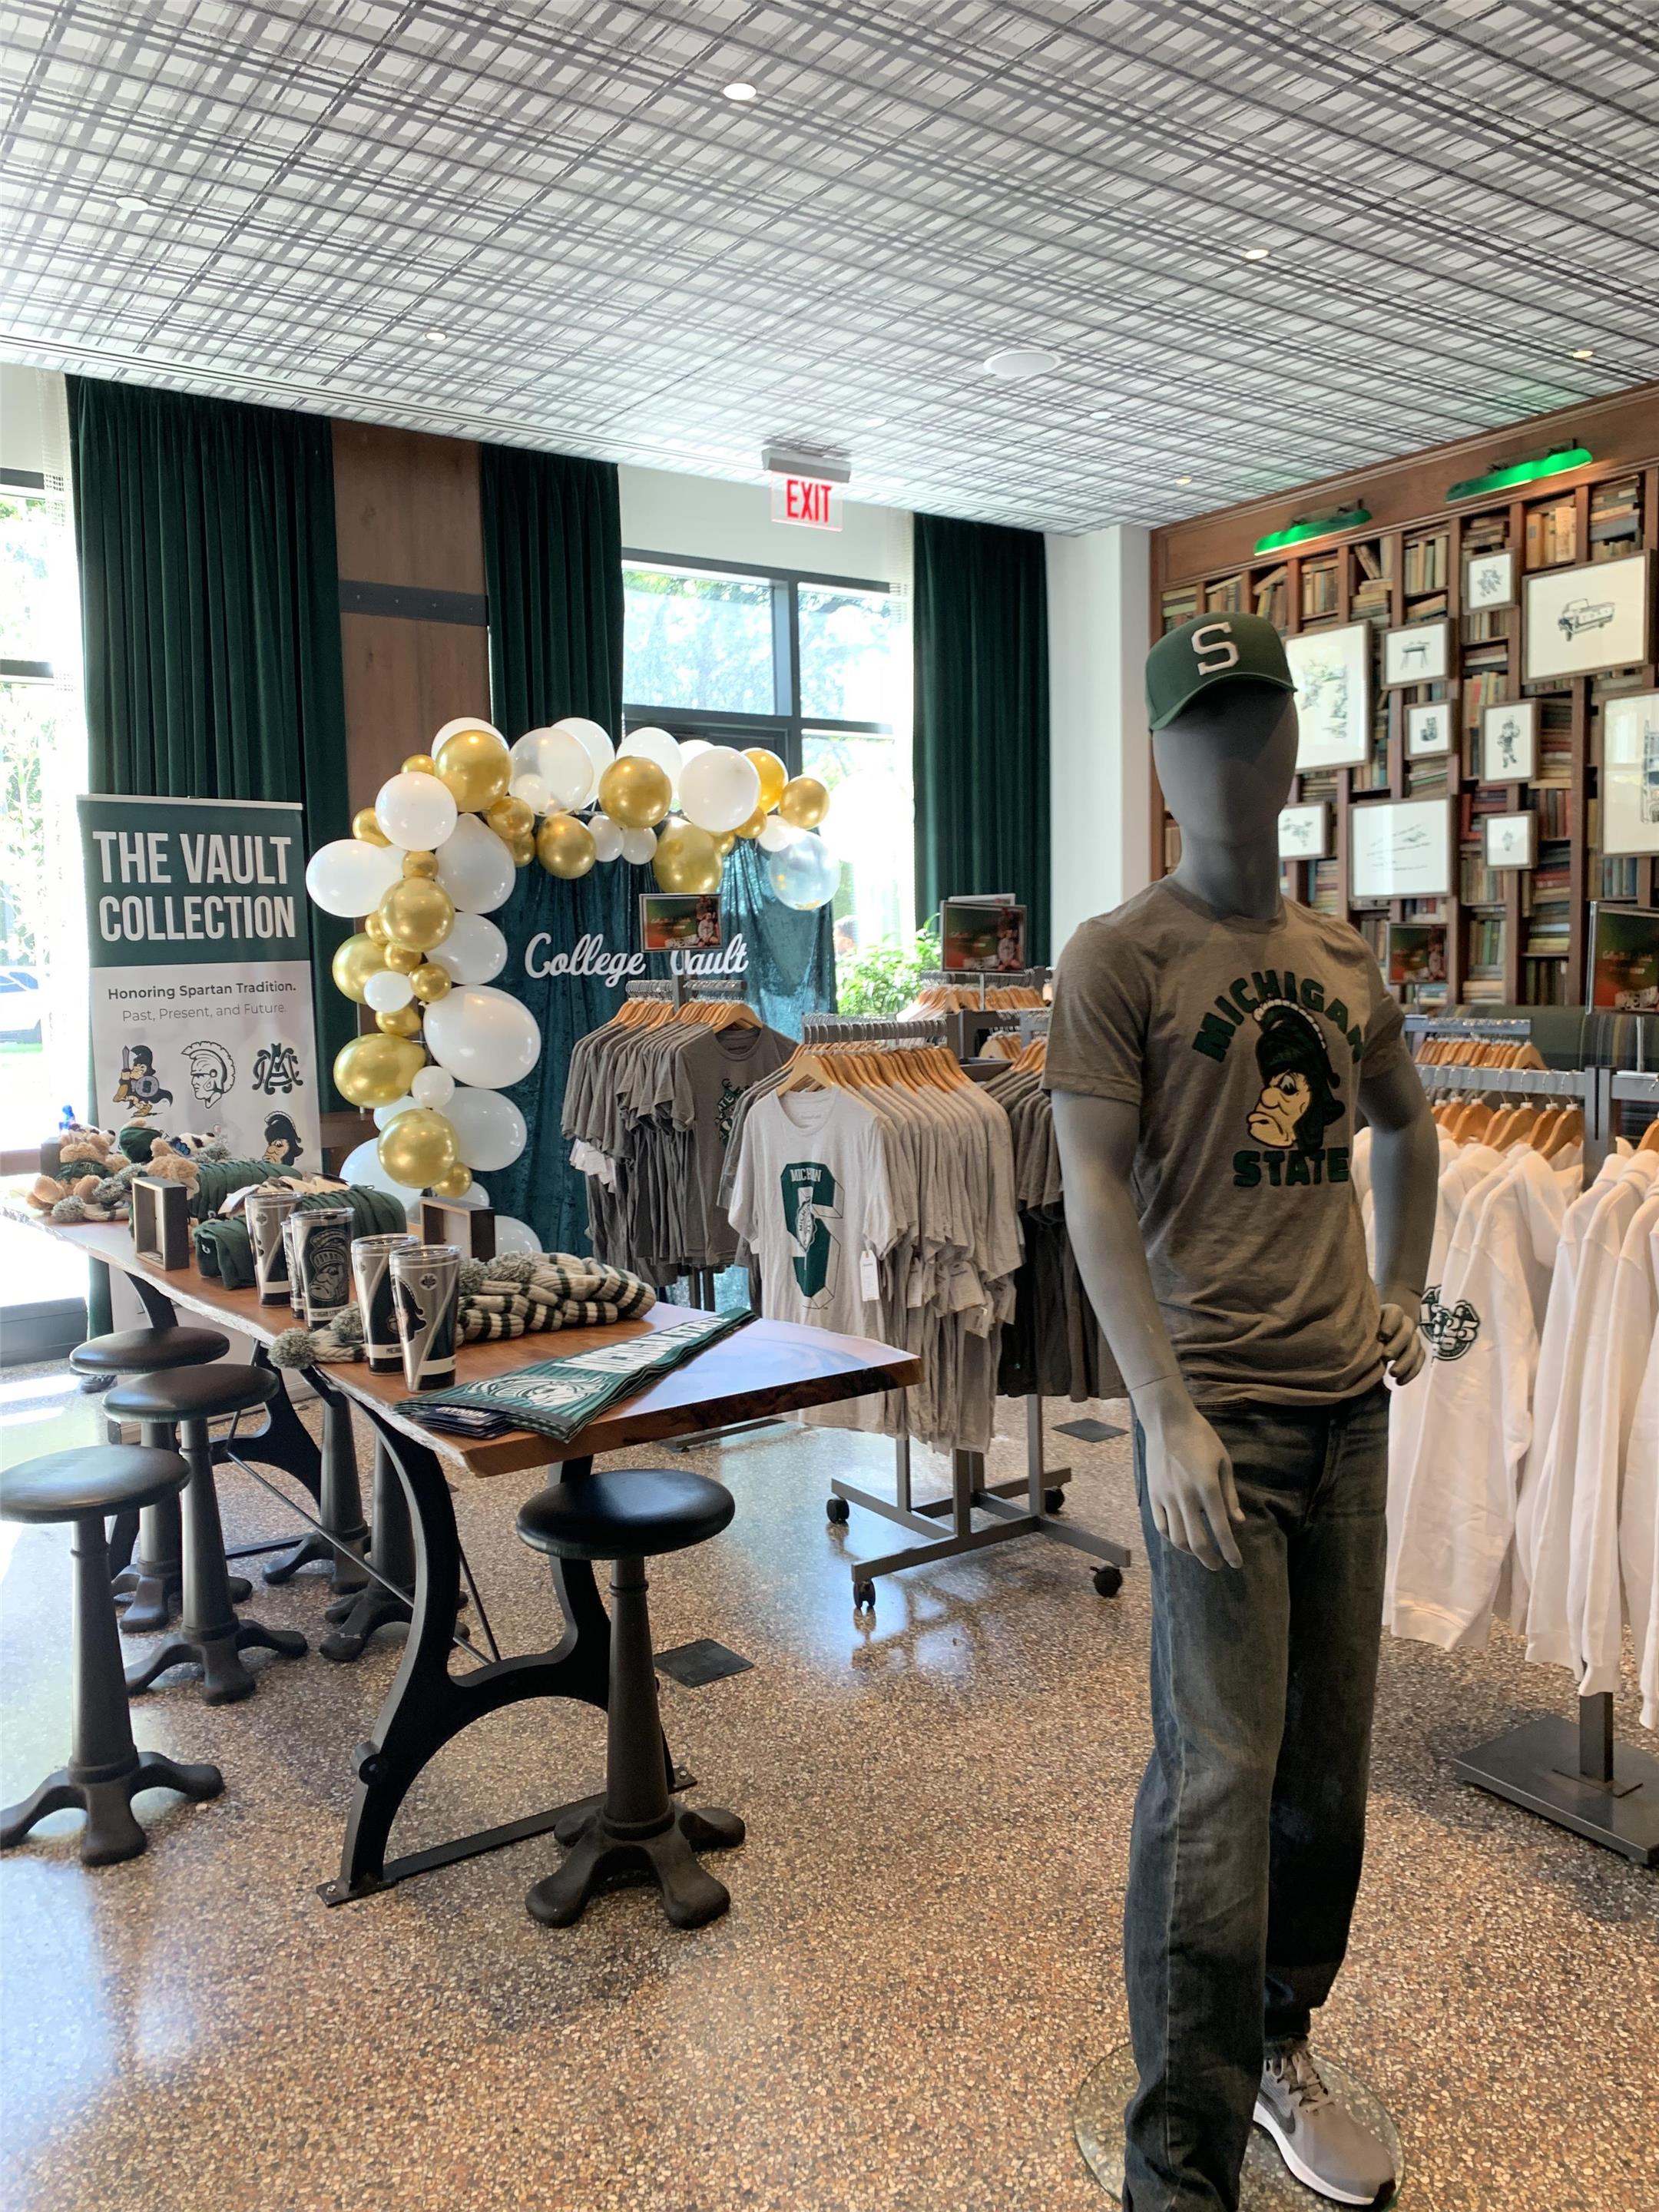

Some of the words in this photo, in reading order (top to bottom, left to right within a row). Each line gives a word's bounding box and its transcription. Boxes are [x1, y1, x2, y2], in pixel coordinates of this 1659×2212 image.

[786, 479, 833, 522] EXIT
[1191, 622, 1239, 675] S
[92, 831, 171, 883] THE
[179, 833, 291, 884] VAULT
[99, 896, 296, 942] COLLECTION
[525, 932, 646, 988] College
[108, 985, 175, 999] Honoring
[179, 984, 232, 998] Spartan
[236, 981, 296, 993] Tradition.
[122, 1010, 156, 1022] Past,
[159, 1007, 213, 1020] Present,
[216, 1005, 240, 1016] and
[243, 1003, 287, 1015] Future.
[1192, 970, 1364, 1065] MICHIGAN
[1232, 1147, 1349, 1187] STATE
[551, 1333, 680, 1373] MICHIGAN
[659, 1317, 730, 1342] STATE
